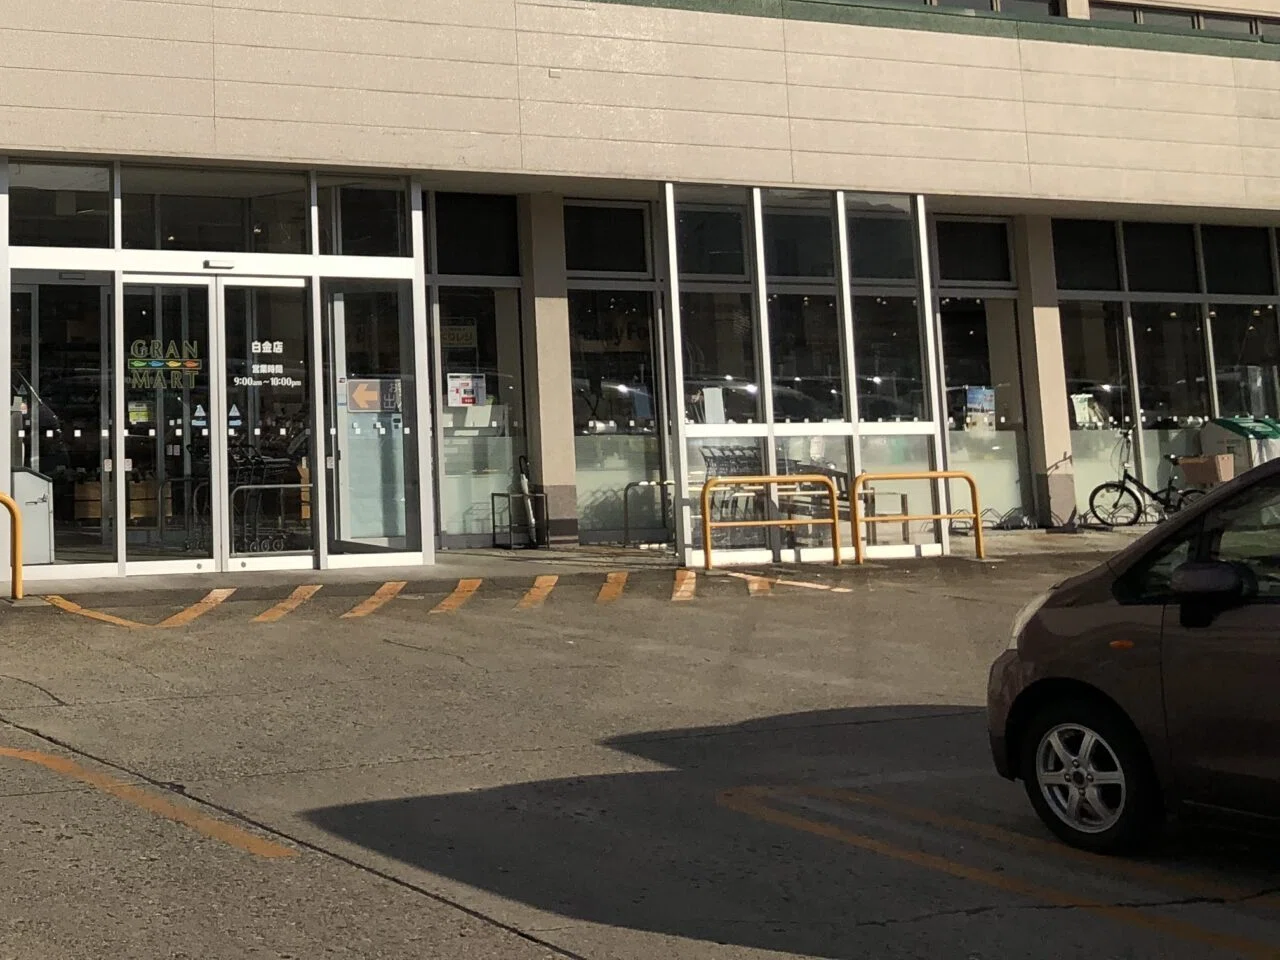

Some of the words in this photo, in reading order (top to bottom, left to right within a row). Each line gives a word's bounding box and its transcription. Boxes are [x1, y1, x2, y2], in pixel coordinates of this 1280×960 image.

[130, 339, 198, 359] GRAN
[251, 340, 284, 354] 白金店
[130, 369, 199, 389] MART
